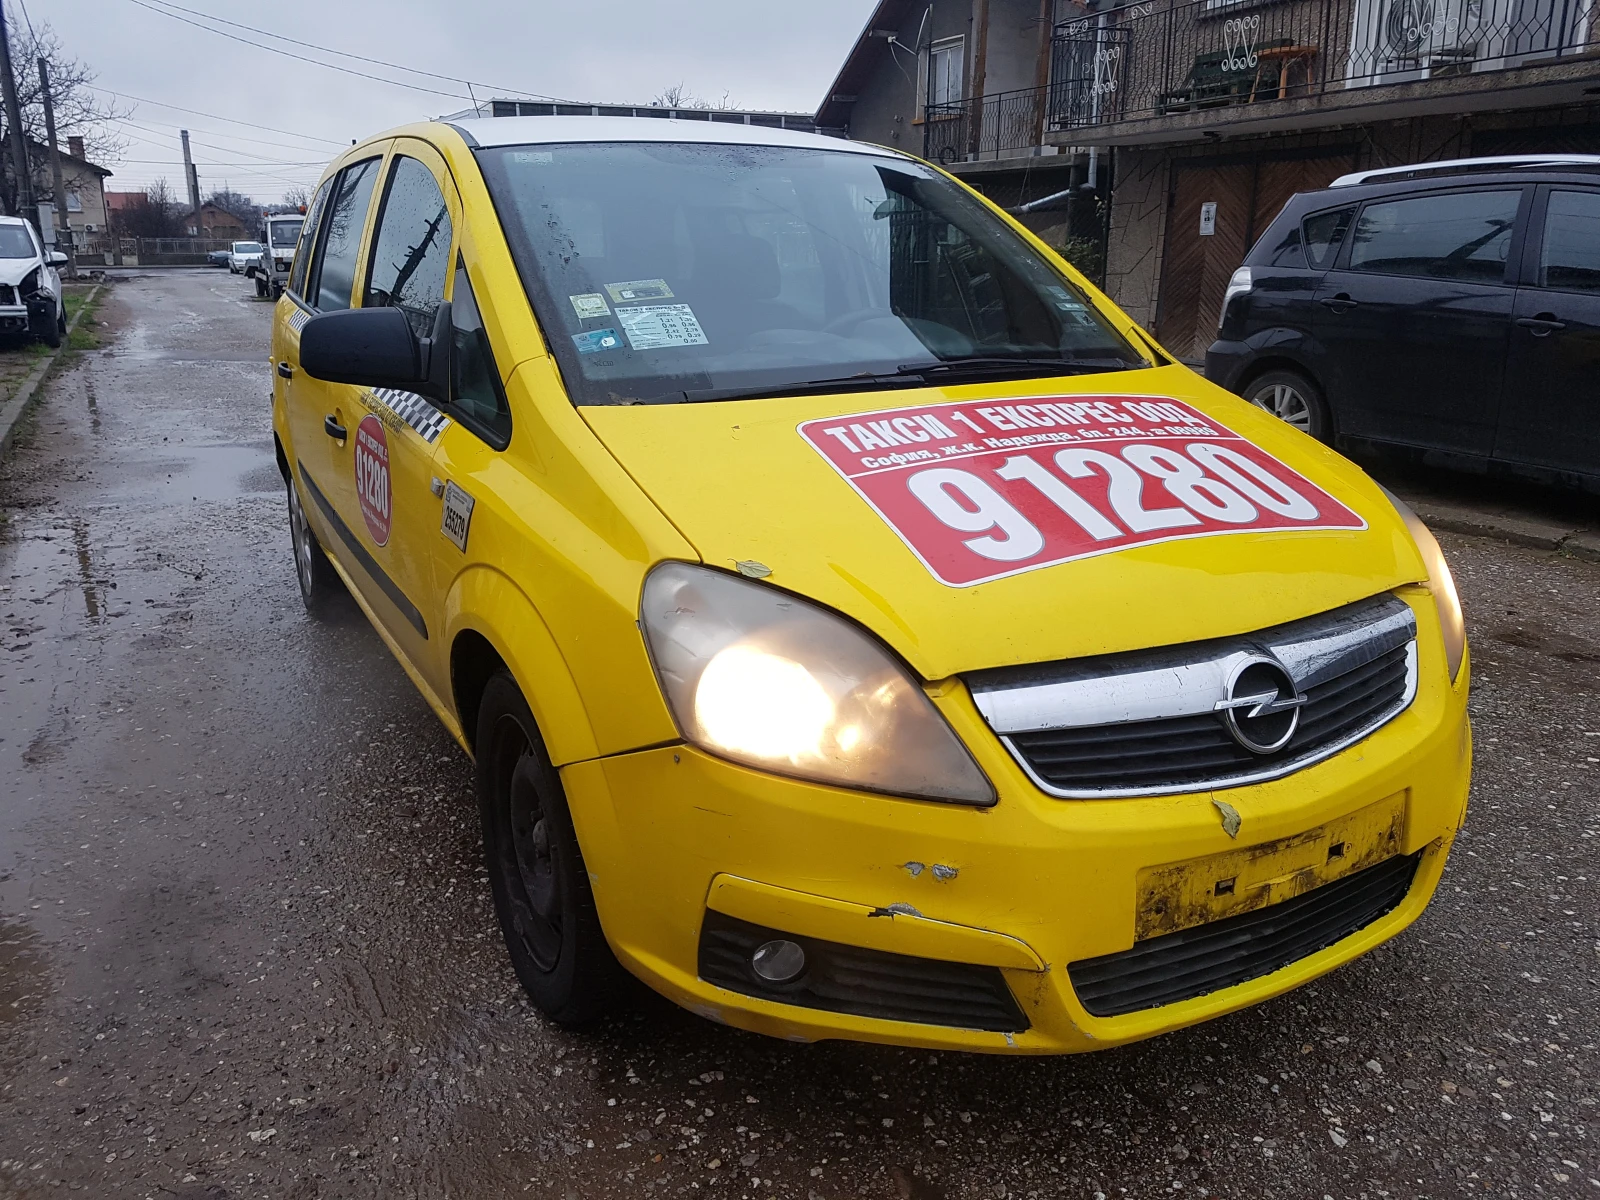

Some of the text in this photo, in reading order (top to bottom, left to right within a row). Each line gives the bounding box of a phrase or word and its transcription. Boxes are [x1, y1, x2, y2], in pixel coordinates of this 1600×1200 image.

[823, 401, 1212, 453] ТАКСИ 1 ЕКСПРЕС ООД
[860, 449, 941, 469] София,
[940, 442, 985, 455] ж.к.
[981, 430, 1080, 448] Надежда,
[1076, 428, 1110, 438] бл.
[356, 444, 388, 519] 91280
[907, 442, 1320, 563] 91280
[444, 505, 466, 541] 255279
